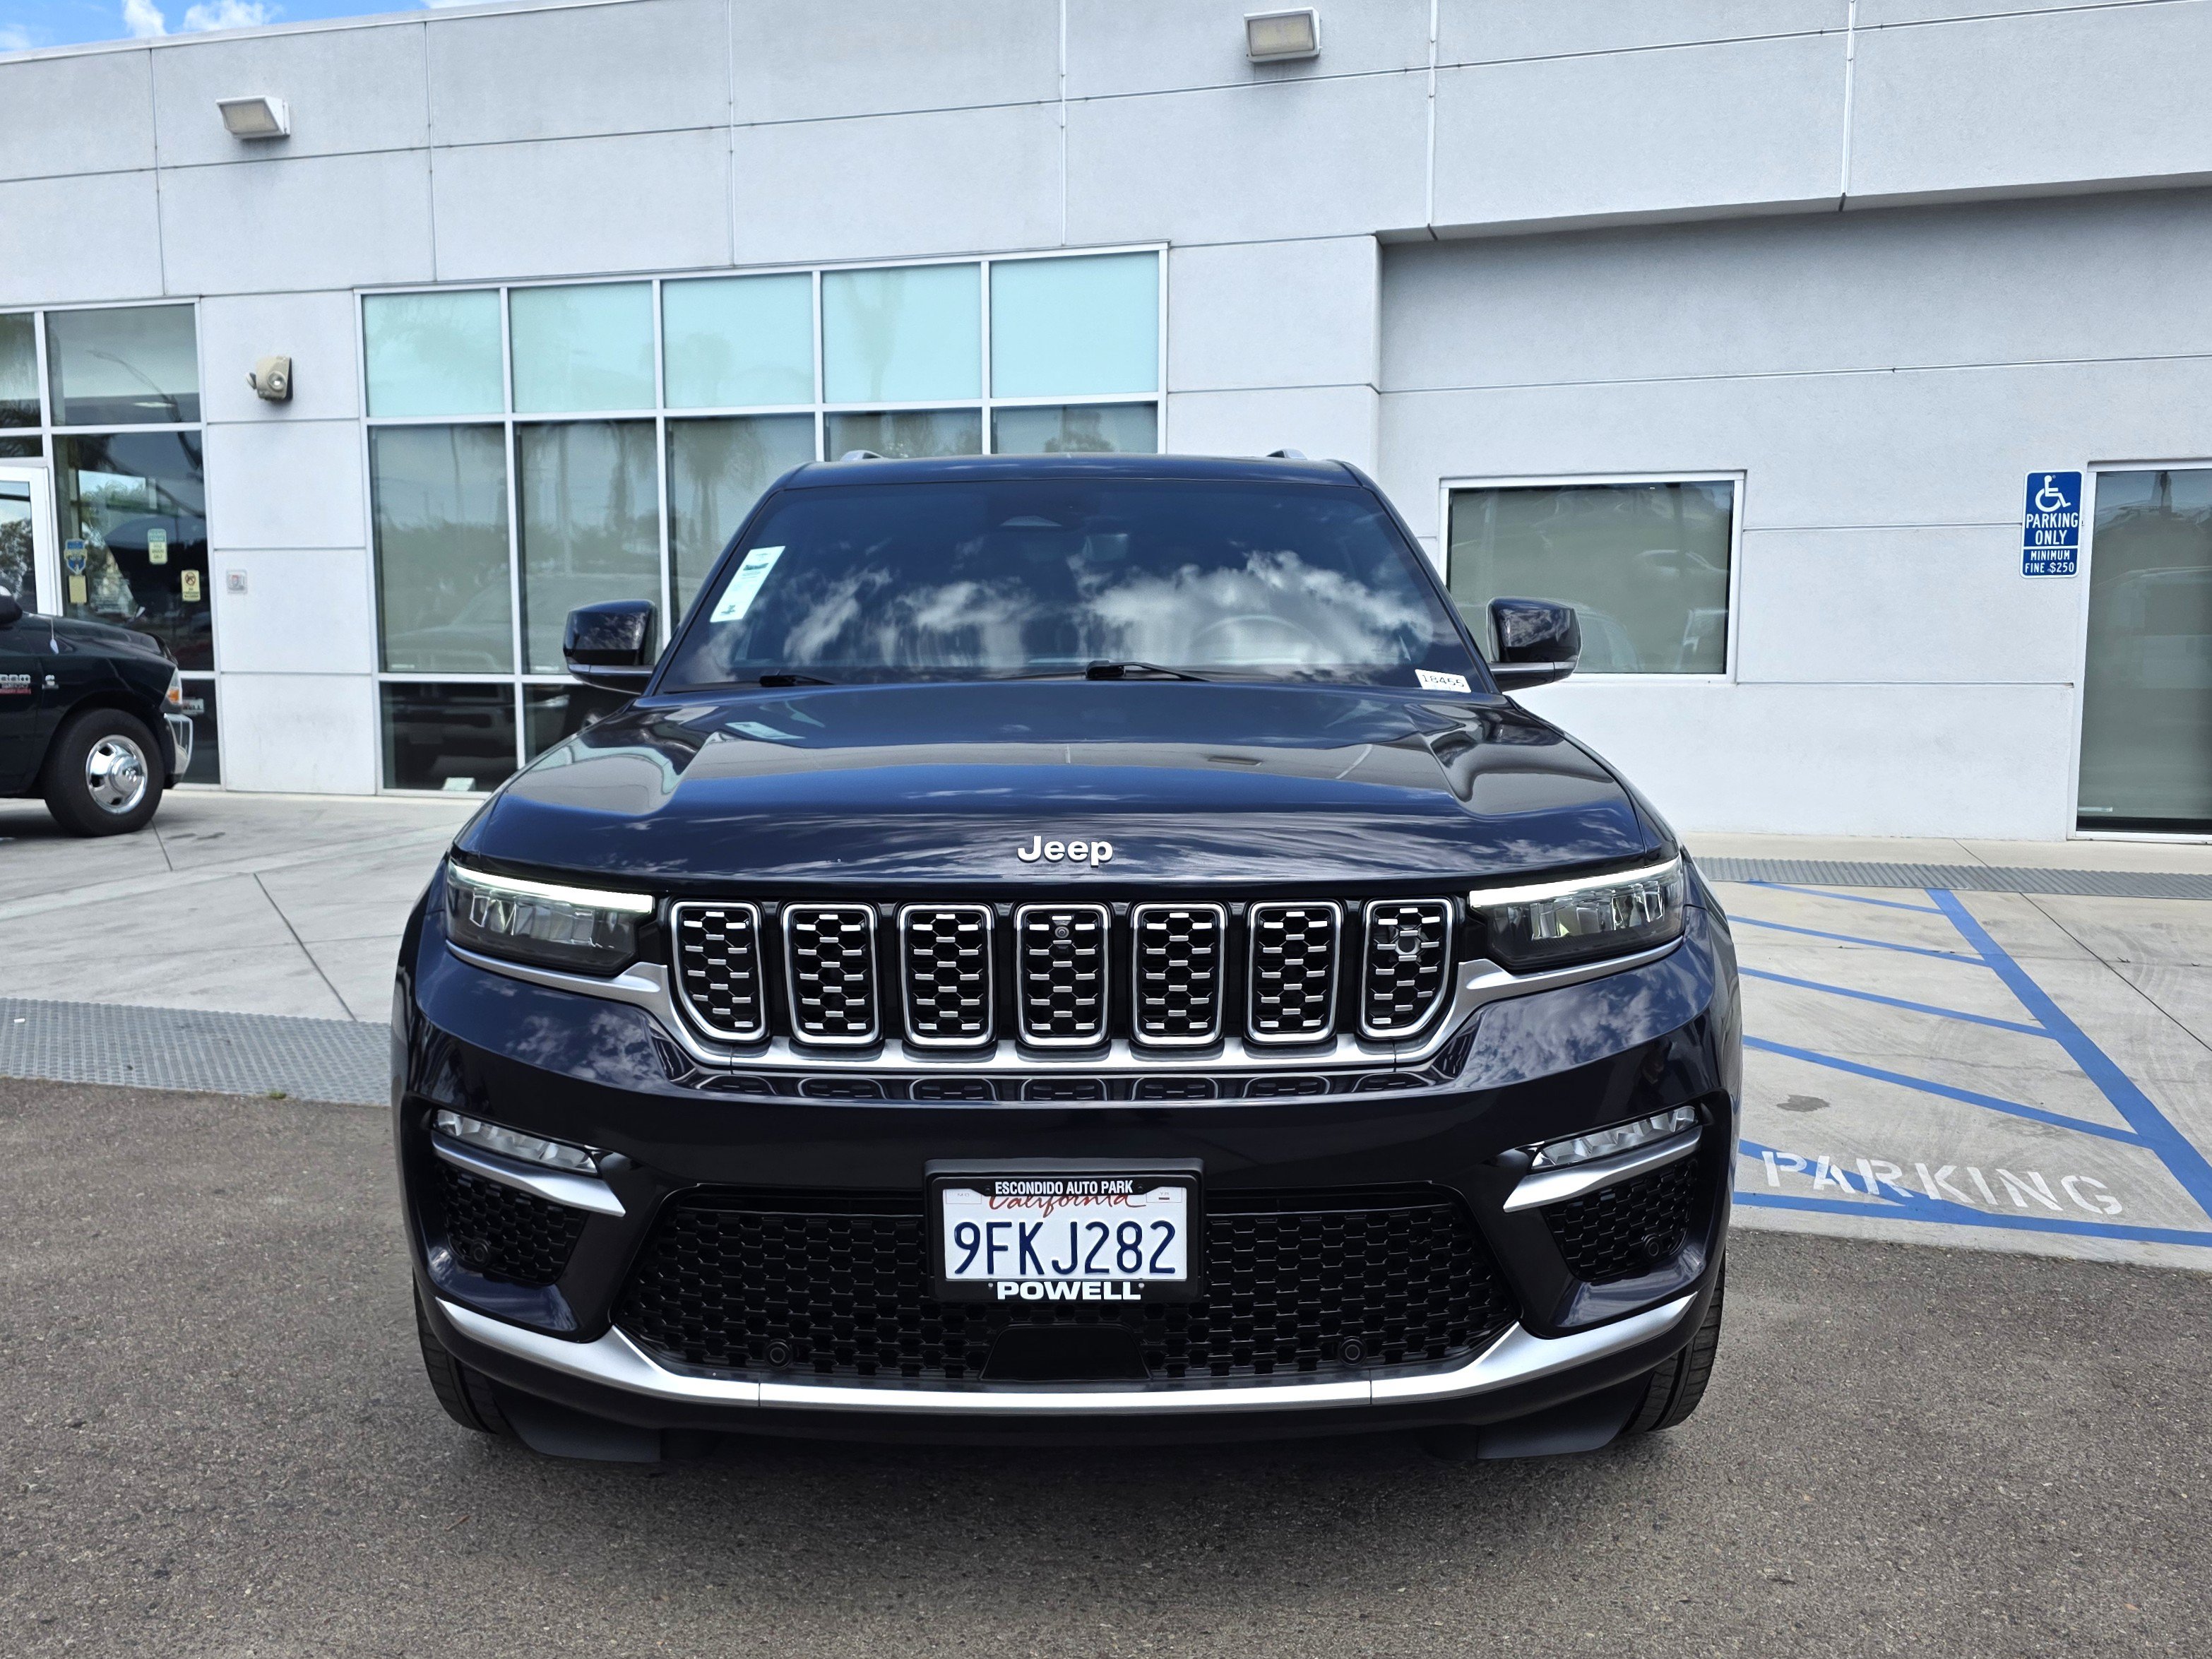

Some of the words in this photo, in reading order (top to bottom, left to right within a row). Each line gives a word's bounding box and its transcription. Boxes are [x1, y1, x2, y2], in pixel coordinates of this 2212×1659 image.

[2026, 513, 2079, 528] PARKING
[2035, 530, 2067, 545] ONLY
[2030, 550, 2070, 561] MINIMUM
[2025, 563, 2045, 573] FINE
[2050, 562, 2074, 573] $250
[1422, 674, 1464, 687] 18455
[1017, 836, 1113, 868] Jeep
[994, 1182, 1063, 1195] ESCONDIDO
[1066, 1181, 1098, 1195] AUTO
[1101, 1180, 1134, 1194] PARK
[1761, 1150, 2123, 1215] PARKING
[954, 1220, 1176, 1276] 9FKJ282
[997, 1280, 1141, 1301] POWELL
